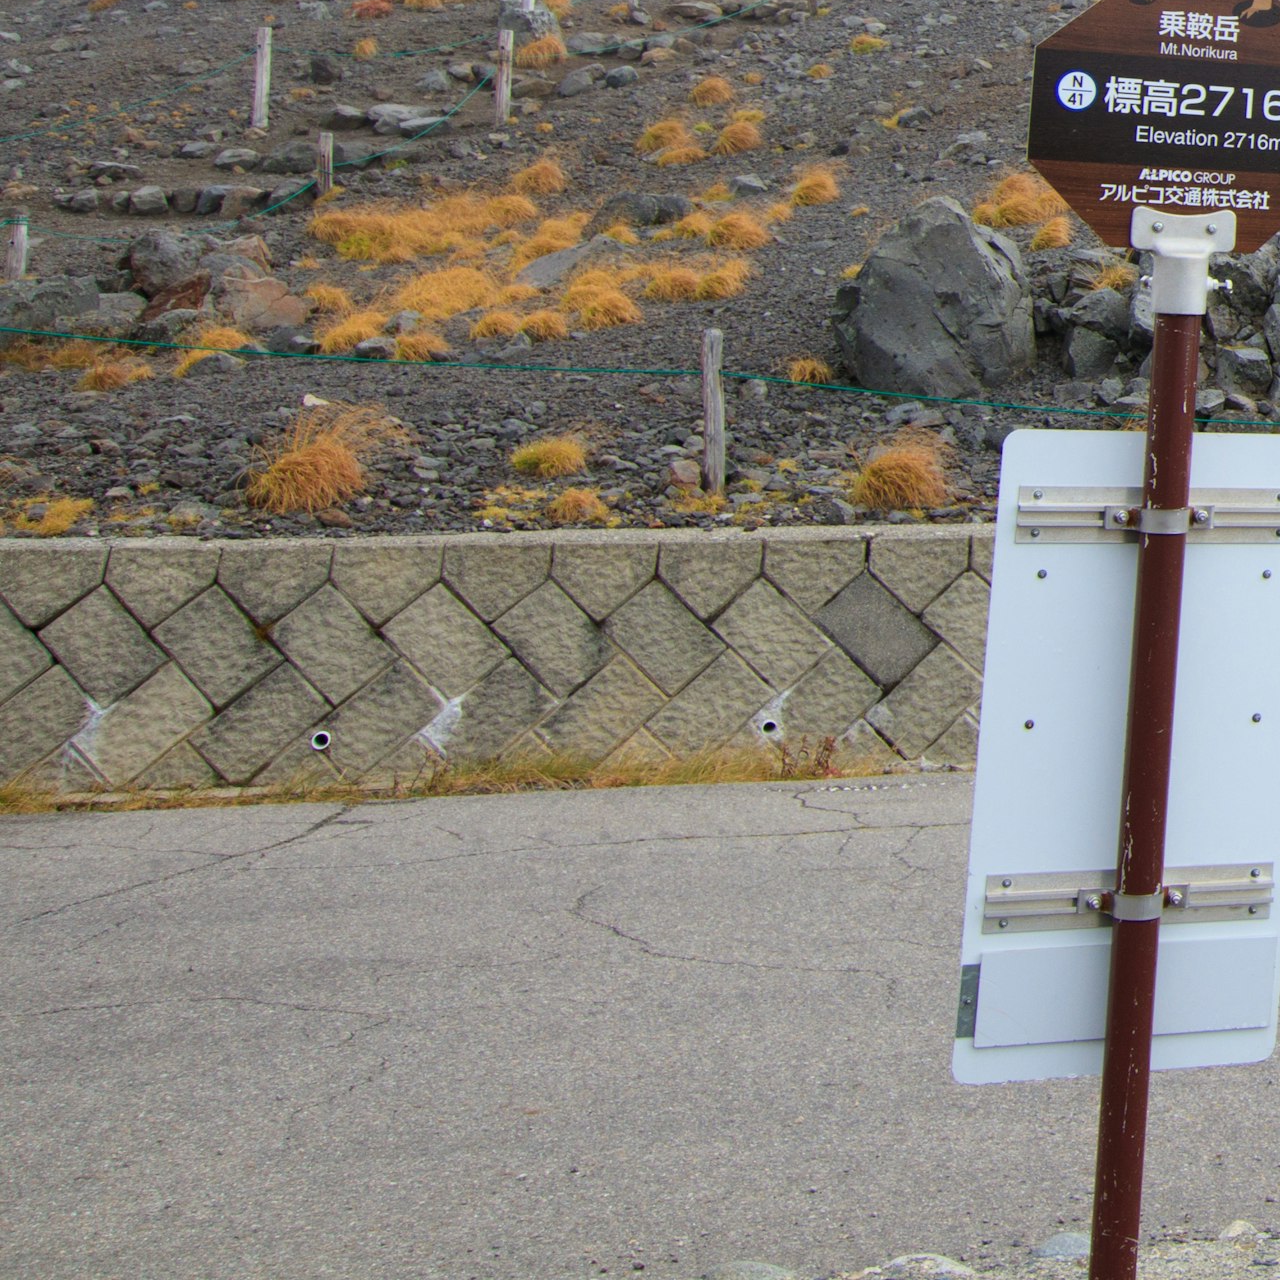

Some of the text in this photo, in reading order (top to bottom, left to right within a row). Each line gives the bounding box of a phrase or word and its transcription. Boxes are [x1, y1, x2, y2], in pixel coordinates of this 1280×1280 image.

[1158, 10, 1240, 42] 乗鞍岳
[1160, 42, 1238, 61] Mt.Norikura
[1072, 75, 1083, 88] N
[1068, 93, 1083, 106] 41
[1135, 125, 1218, 147] Elevation
[1138, 168, 1236, 185] ALPICO GROUP
[1099, 183, 1270, 210] アルピコ交通株式会社
